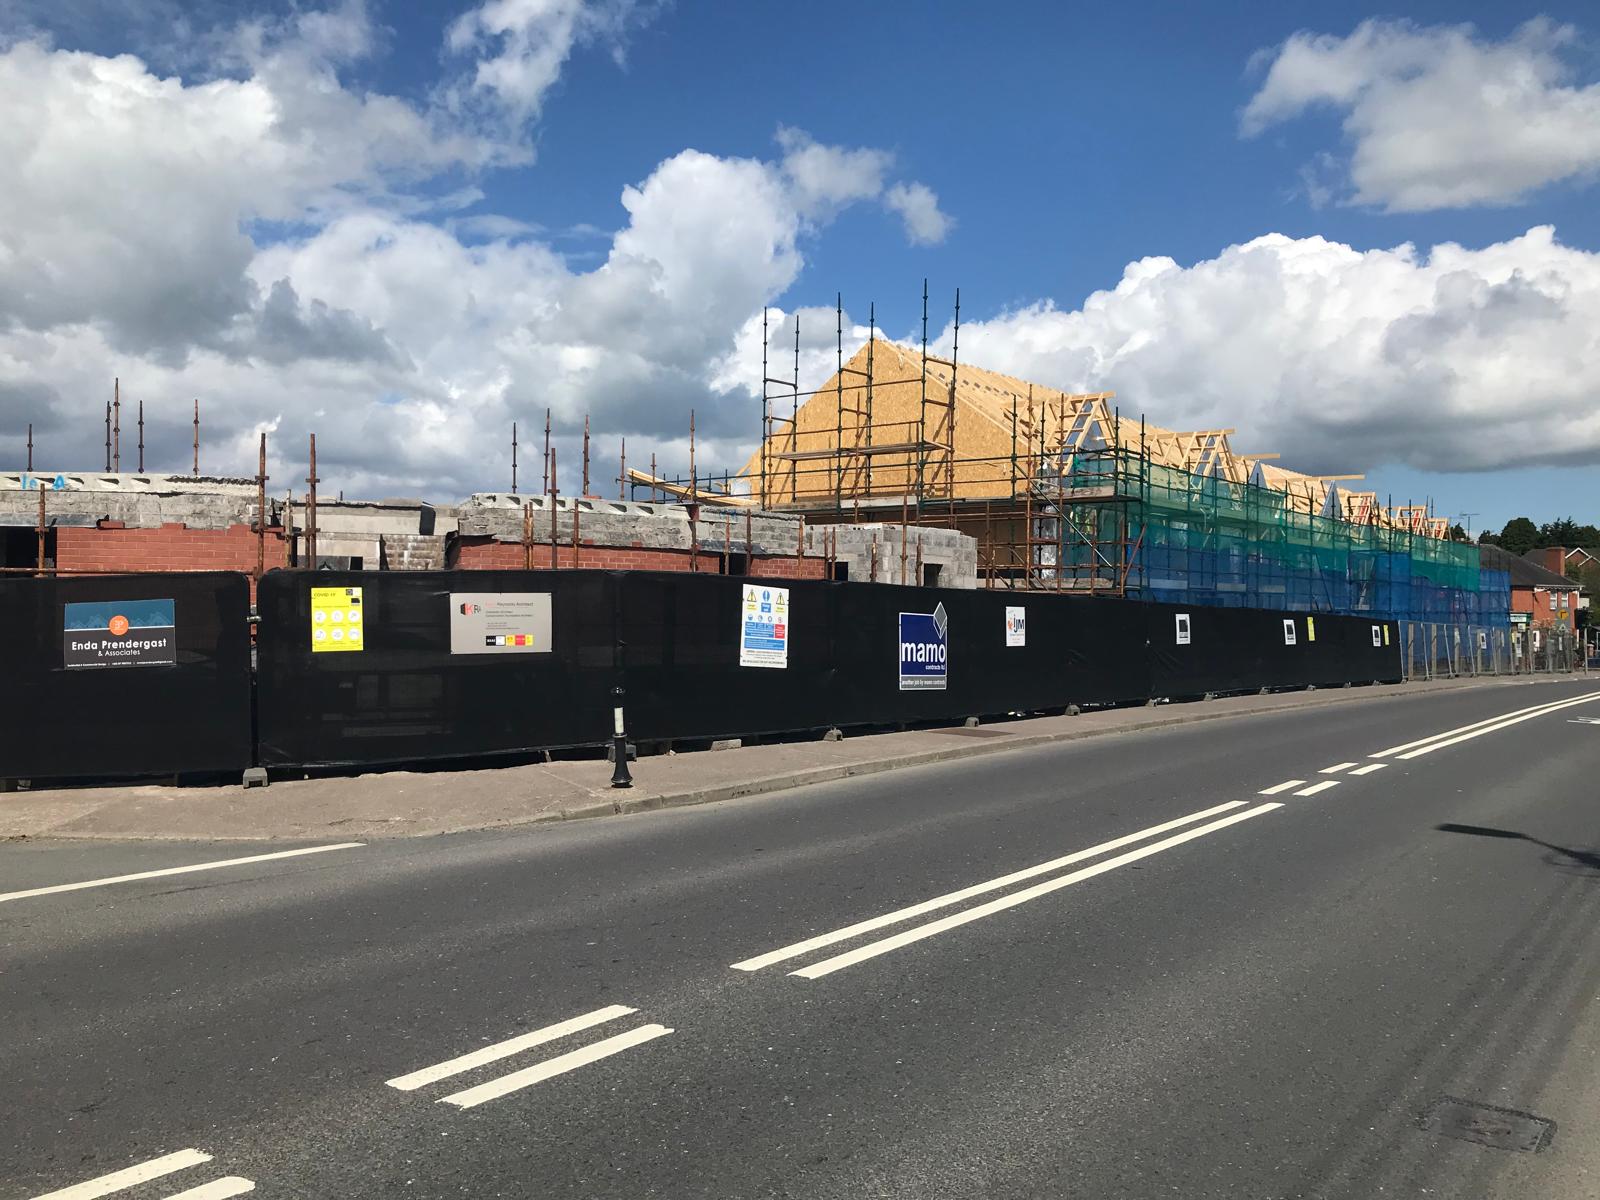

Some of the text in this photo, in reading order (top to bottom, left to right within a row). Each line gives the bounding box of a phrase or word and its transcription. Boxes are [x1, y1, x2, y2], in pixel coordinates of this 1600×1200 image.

[71, 638, 167, 651] Enda Prendergast
[901, 642, 946, 663] mamo
